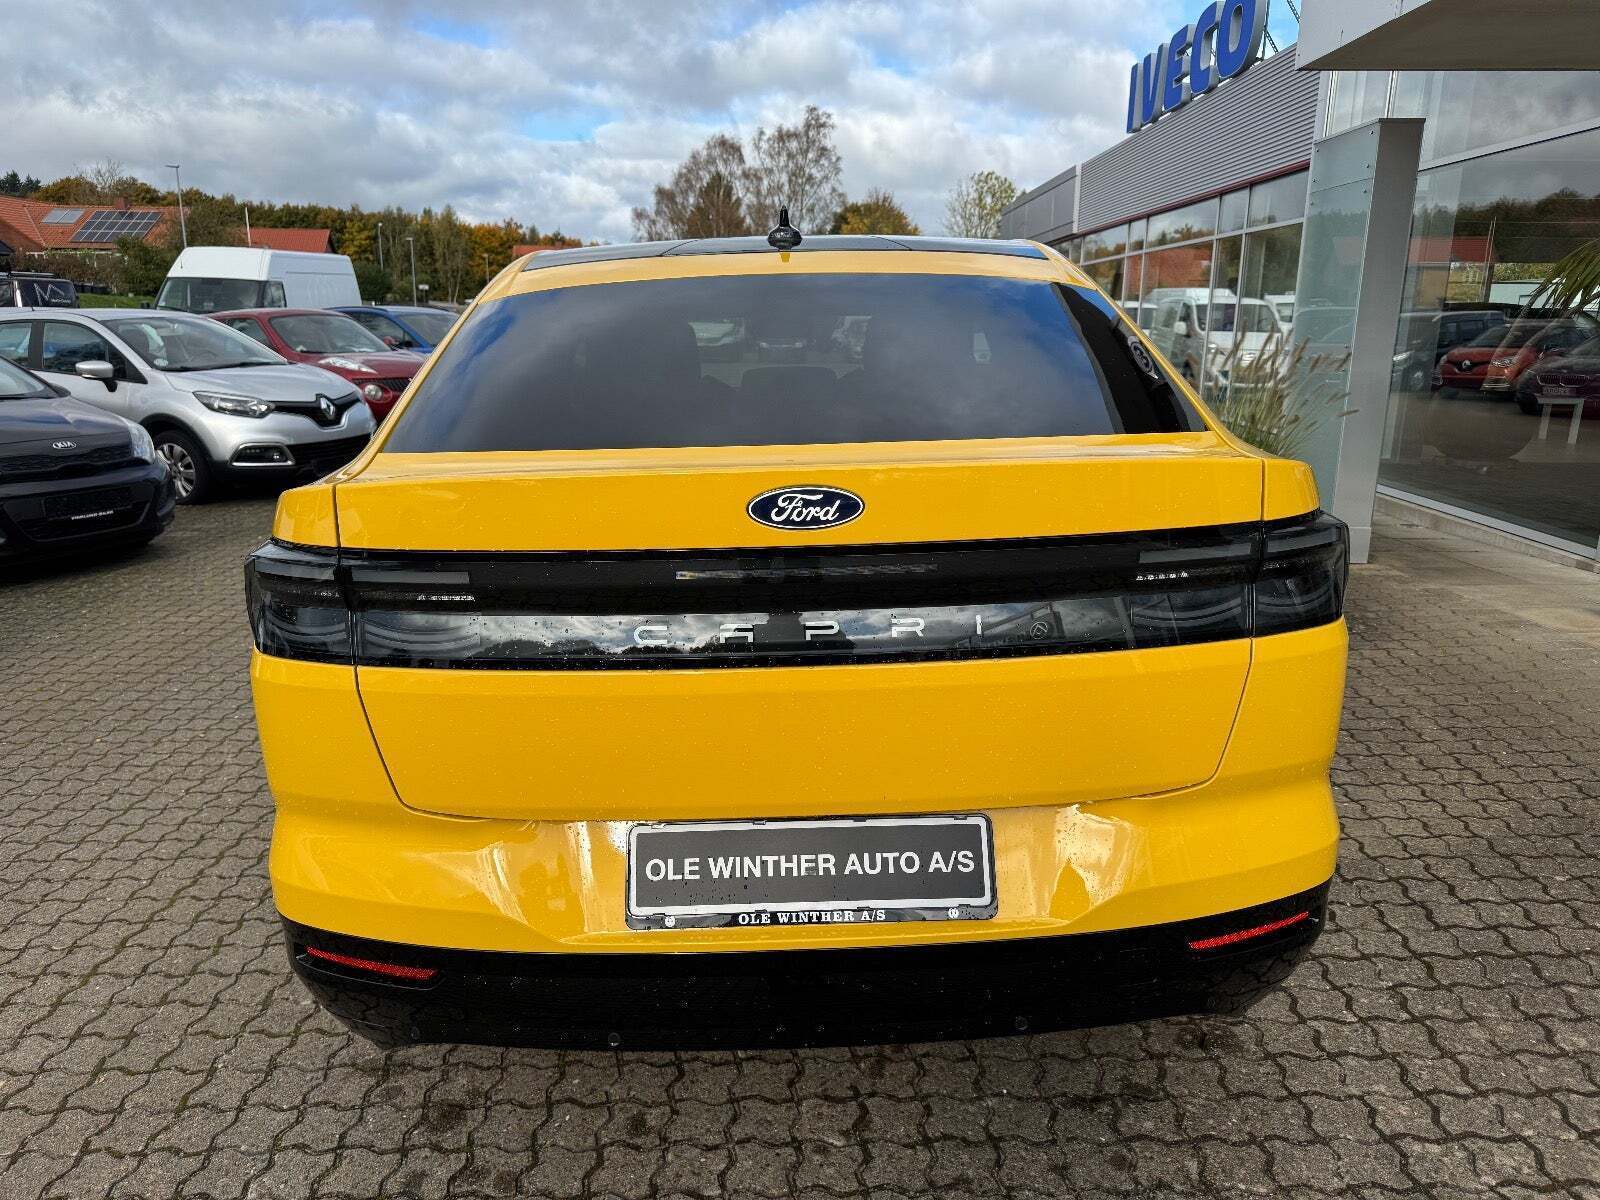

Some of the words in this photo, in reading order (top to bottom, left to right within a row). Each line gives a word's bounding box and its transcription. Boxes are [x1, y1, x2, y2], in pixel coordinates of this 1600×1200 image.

[1126, 0, 1265, 134] IVECO
[53, 441, 76, 450] KIA
[770, 493, 841, 522] Ford
[633, 614, 982, 646] CAPRI
[645, 857, 701, 882] OLE
[707, 853, 836, 879] WINTHER
[844, 851, 920, 875] AUTO
[928, 850, 975, 873] A/S
[738, 912, 771, 925] OLE
[776, 909, 855, 924] WINTHER
[860, 909, 886, 922] A/S
